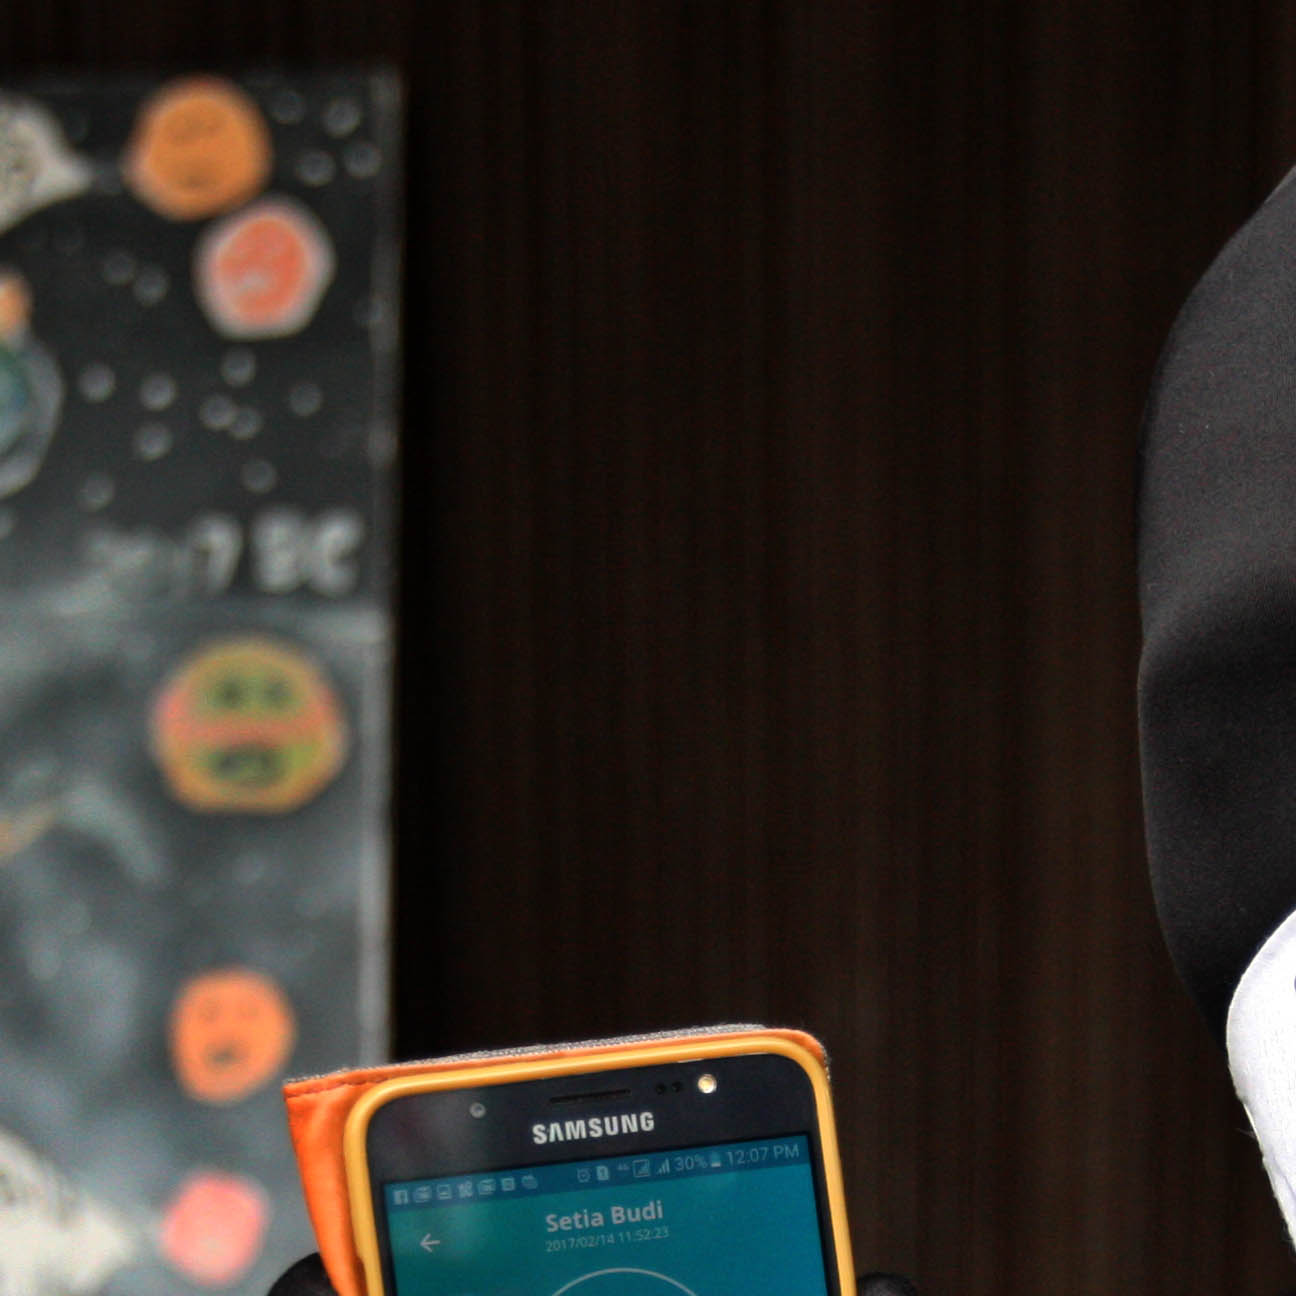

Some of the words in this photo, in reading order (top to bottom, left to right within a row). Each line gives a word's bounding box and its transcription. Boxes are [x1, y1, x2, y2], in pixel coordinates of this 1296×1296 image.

[532, 1112, 655, 1145] SAMSUNG
[674, 1155, 706, 1172] 30%
[728, 1148, 768, 1166] 12:07
[774, 1144, 799, 1160] PM
[546, 1209, 604, 1233] Setia
[611, 1200, 663, 1225] Budi
[546, 1233, 615, 1252] 2017/02/14
